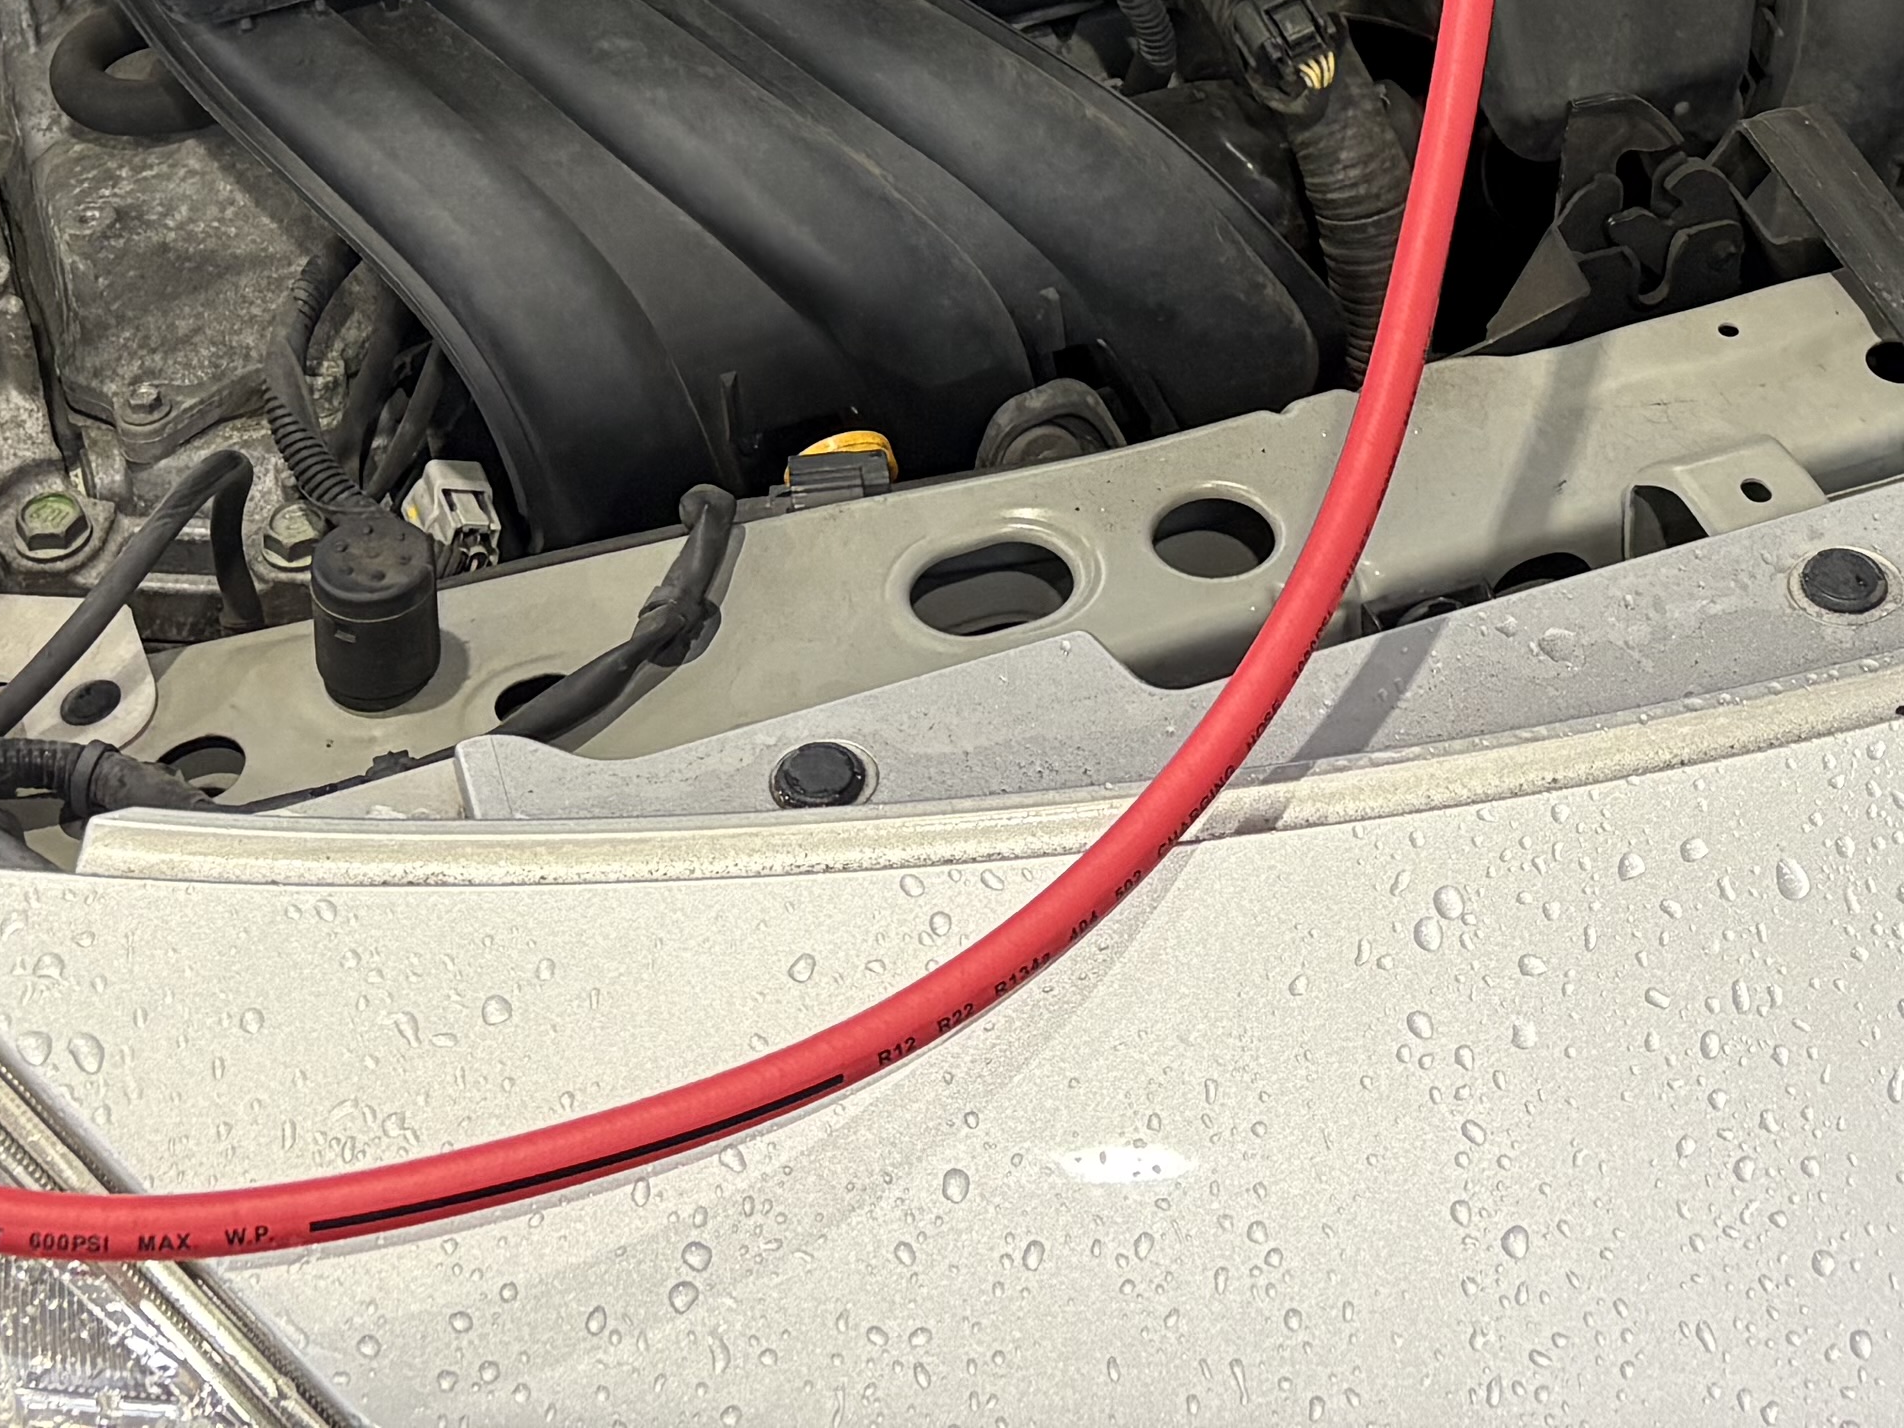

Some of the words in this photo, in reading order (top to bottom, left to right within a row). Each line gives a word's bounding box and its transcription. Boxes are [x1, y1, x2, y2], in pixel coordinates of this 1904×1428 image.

[877, 1036, 917, 1066] R12
[936, 1002, 974, 1034] R22
[29, 1232, 110, 1254] 600PSI
[224, 1224, 275, 1246] W.P.
